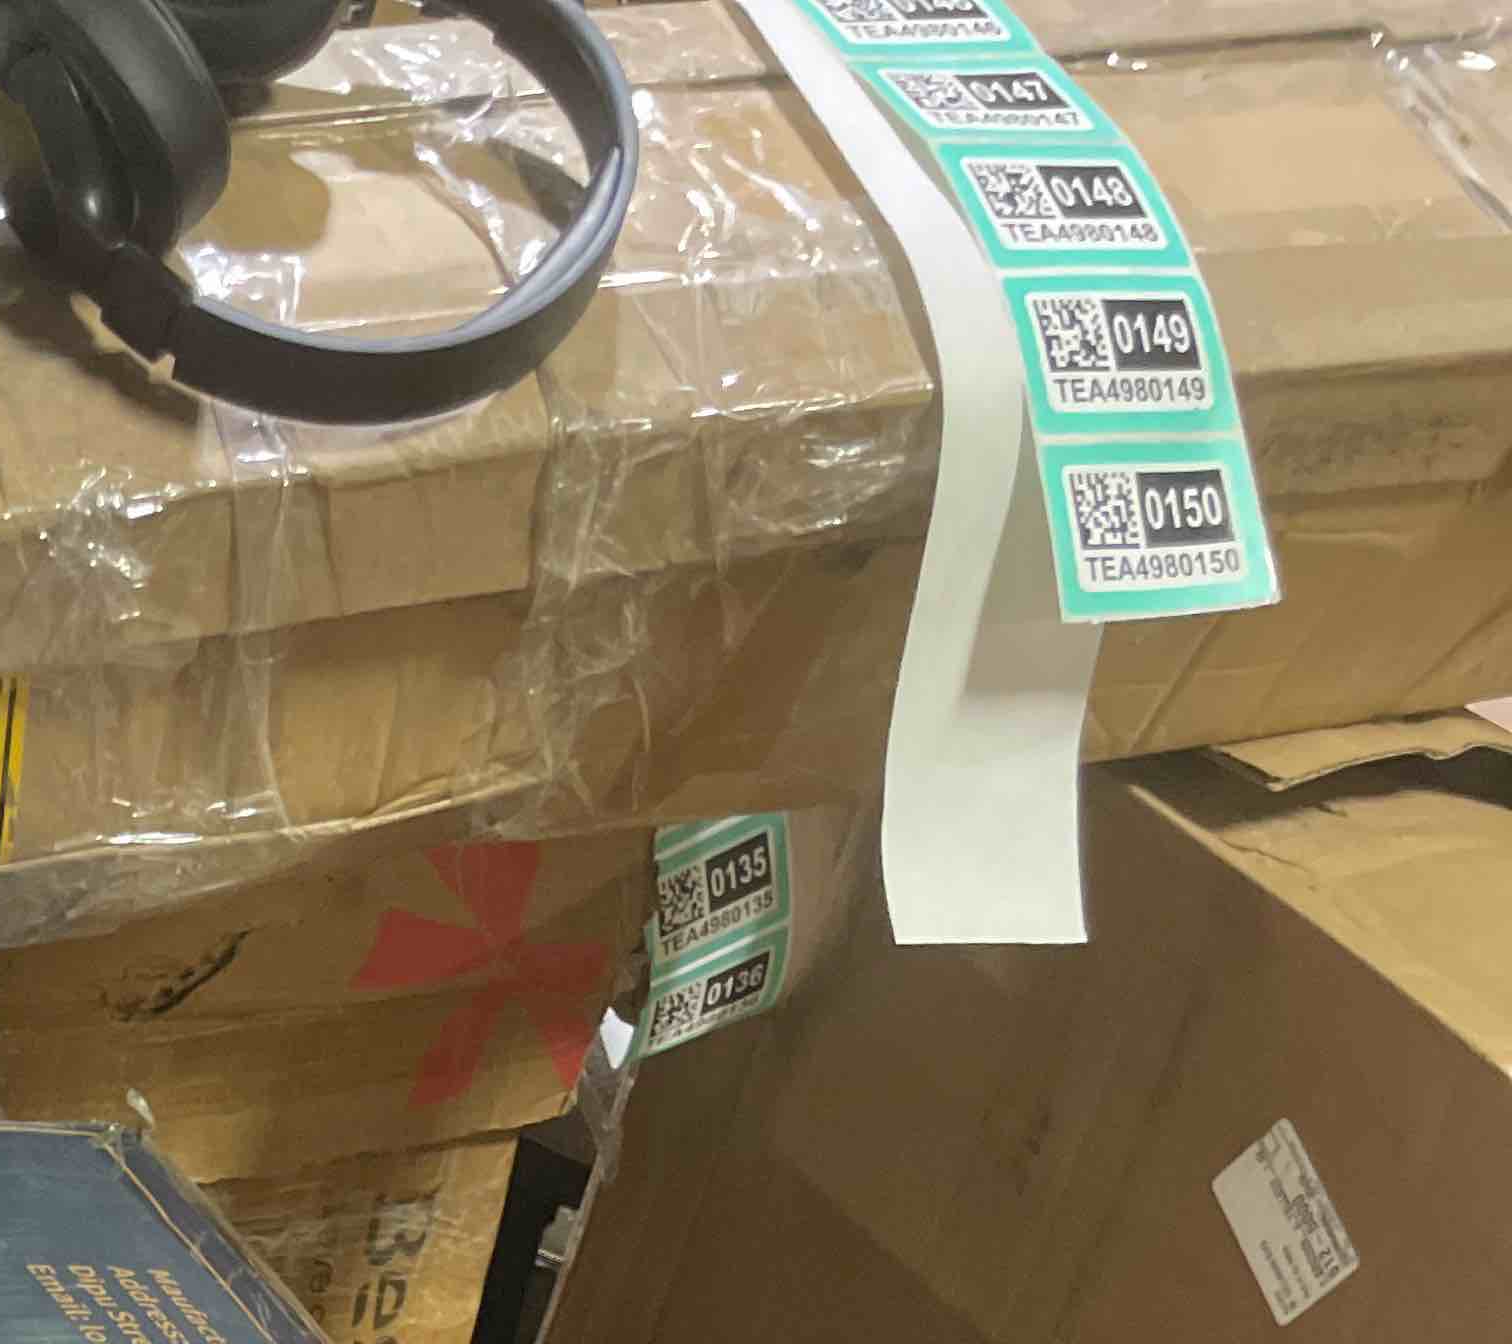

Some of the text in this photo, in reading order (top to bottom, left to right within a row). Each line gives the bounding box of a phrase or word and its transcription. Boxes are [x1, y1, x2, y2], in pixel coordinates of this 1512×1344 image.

[968, 79, 1049, 104] 0147
[1050, 175, 1133, 207] 0148
[1000, 223, 1159, 243] TEA4980148
[1112, 312, 1190, 354] 0149
[1052, 376, 1206, 403] TEA4980149
[1144, 484, 1223, 530] 0150
[1083, 548, 1240, 582] TEA4980150
[710, 846, 768, 897] 0135
[660, 894, 774, 958] TEA4980135
[706, 964, 764, 1005] 0136
[26, 1264, 93, 1321] Email:
[66, 1264, 118, 1308] Dipu
